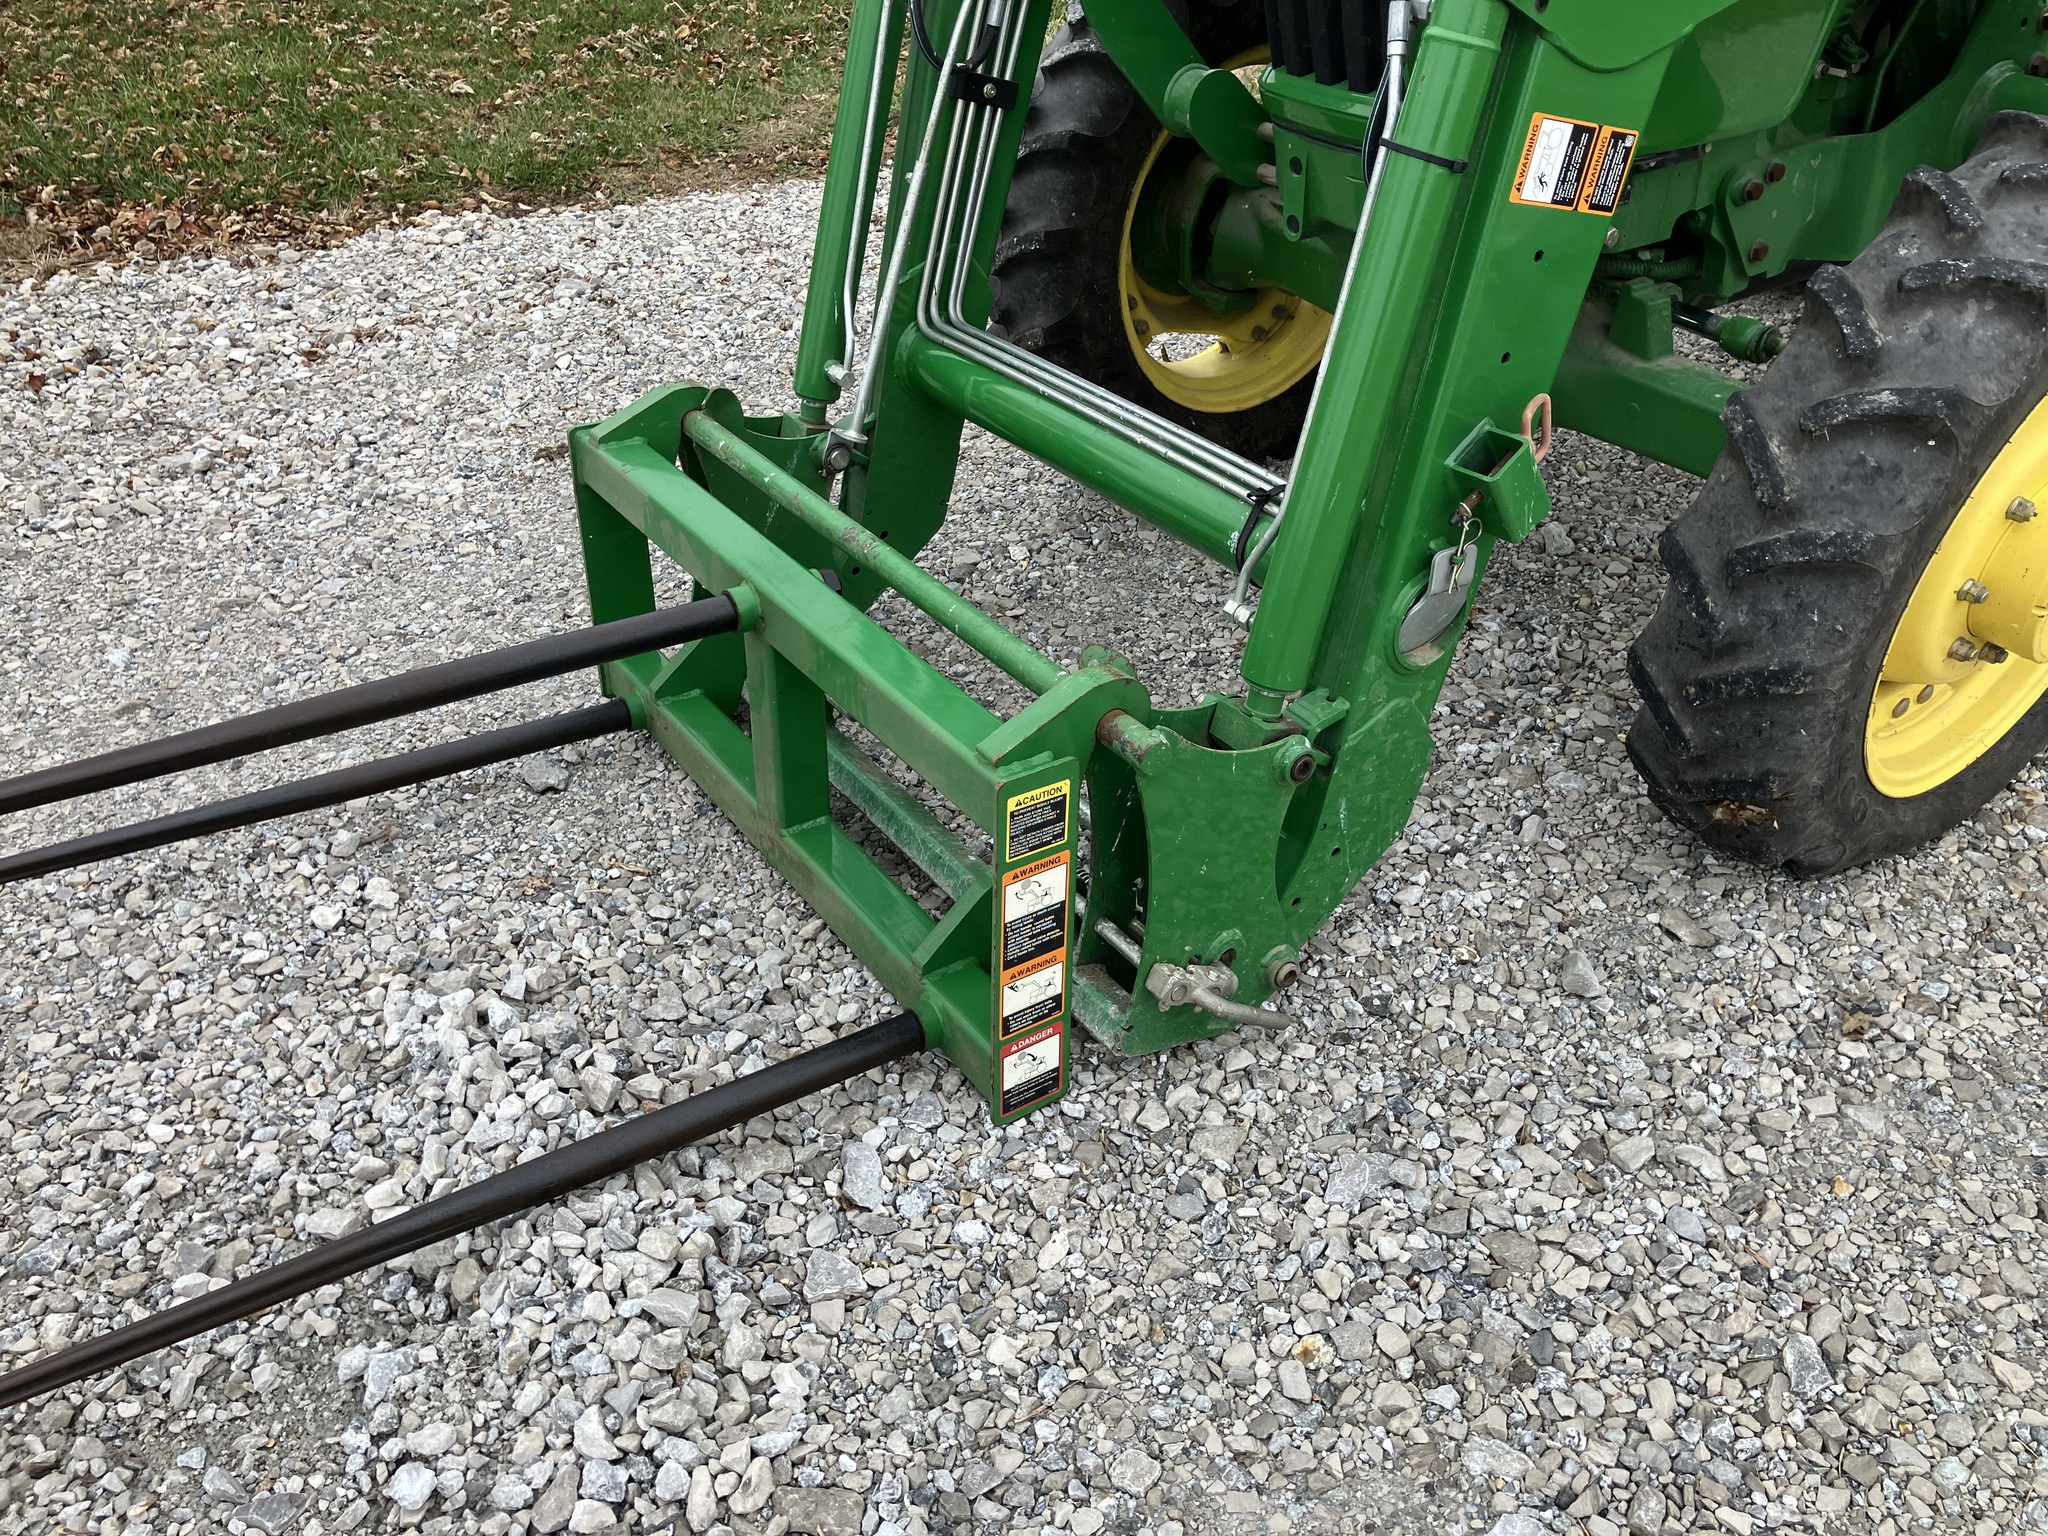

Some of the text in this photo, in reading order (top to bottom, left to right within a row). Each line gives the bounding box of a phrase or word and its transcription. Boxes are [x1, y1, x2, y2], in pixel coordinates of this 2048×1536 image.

[1519, 124, 1539, 179] WARNING
[1587, 136, 1608, 188] WARNING
[1022, 786, 1062, 805] CAUTION
[1020, 856, 1061, 877] WARNING
[1017, 956, 1057, 977] WARNING
[1018, 1027, 1053, 1049] DANGER
